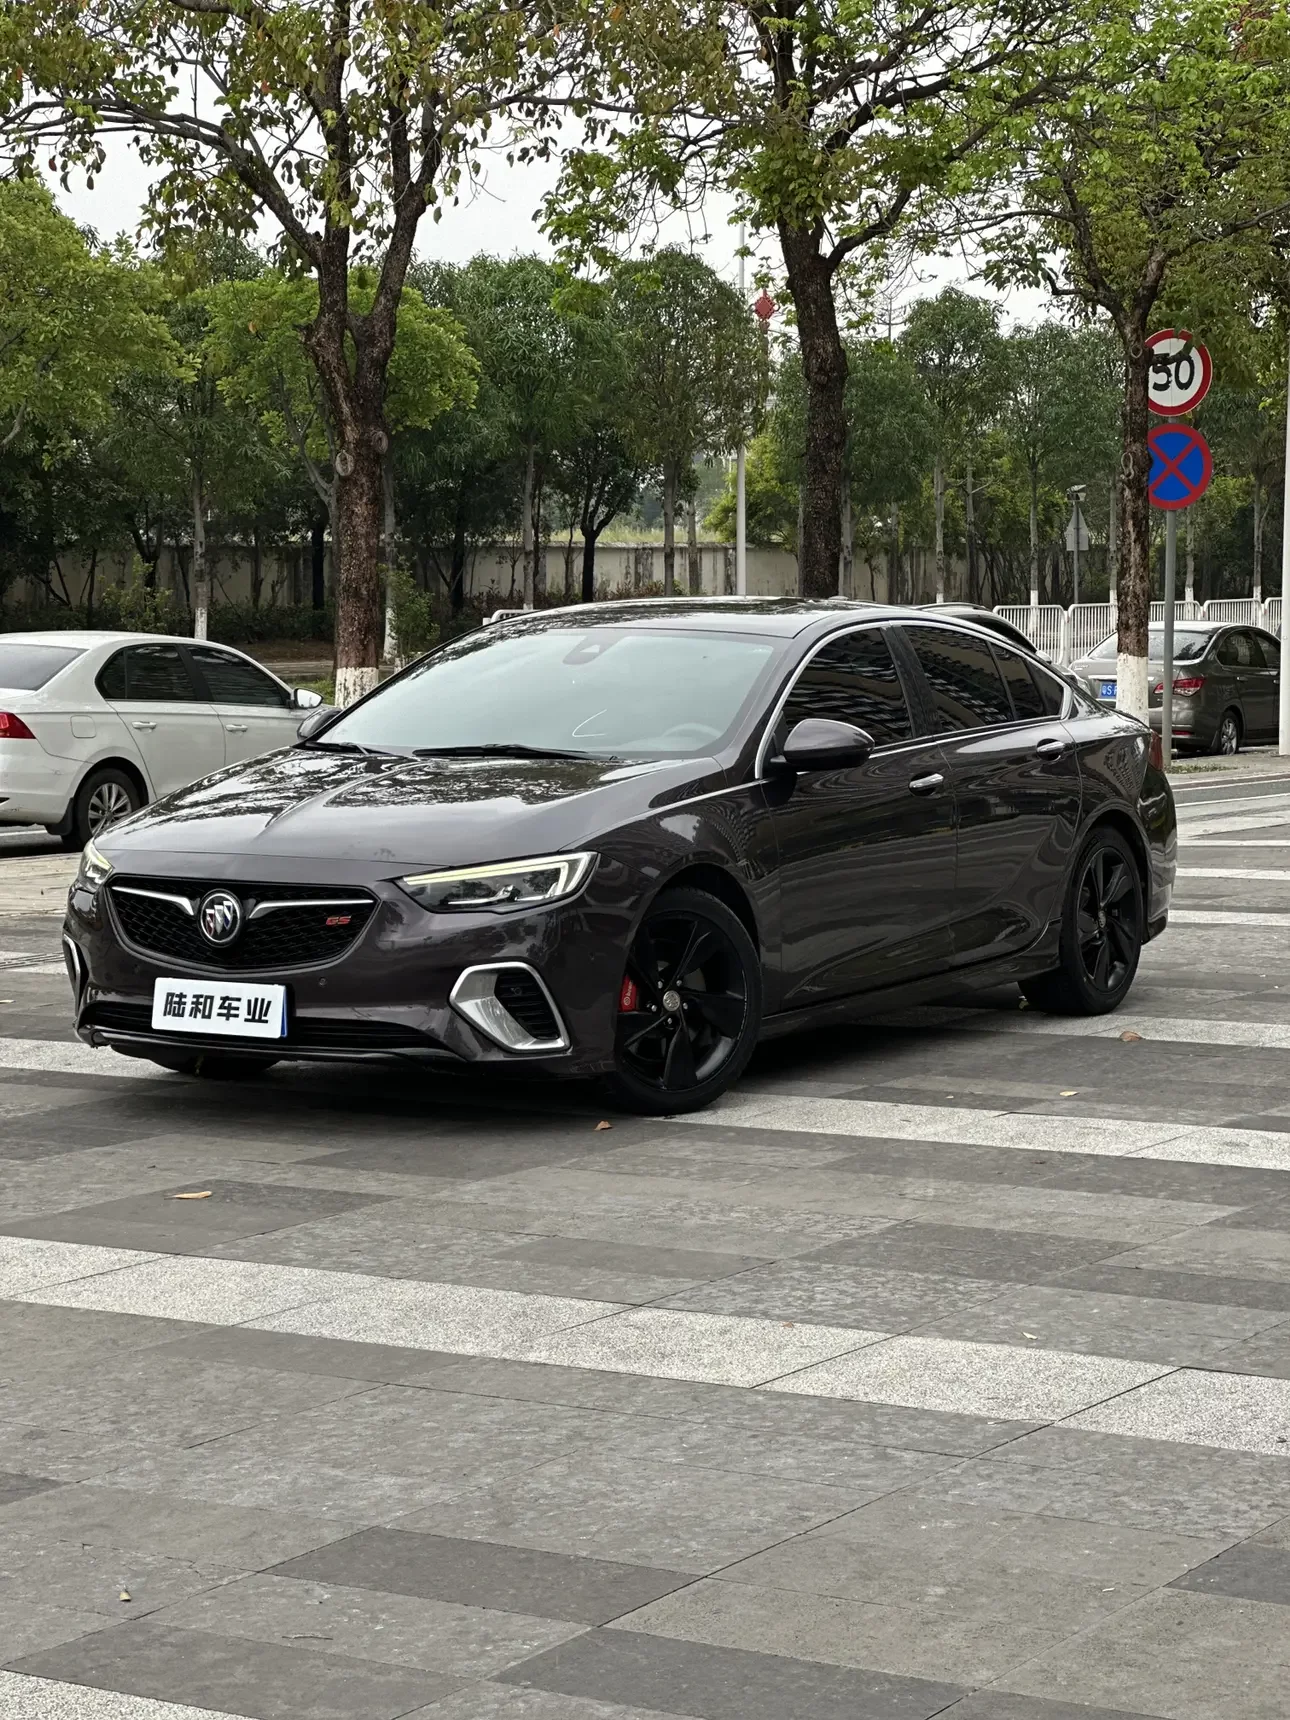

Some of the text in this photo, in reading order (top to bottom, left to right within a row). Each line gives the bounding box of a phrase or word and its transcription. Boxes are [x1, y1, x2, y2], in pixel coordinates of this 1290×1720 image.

[1152, 353, 1195, 391] 50
[326, 916, 351, 925] GS
[163, 992, 272, 1024] 陆和车业
